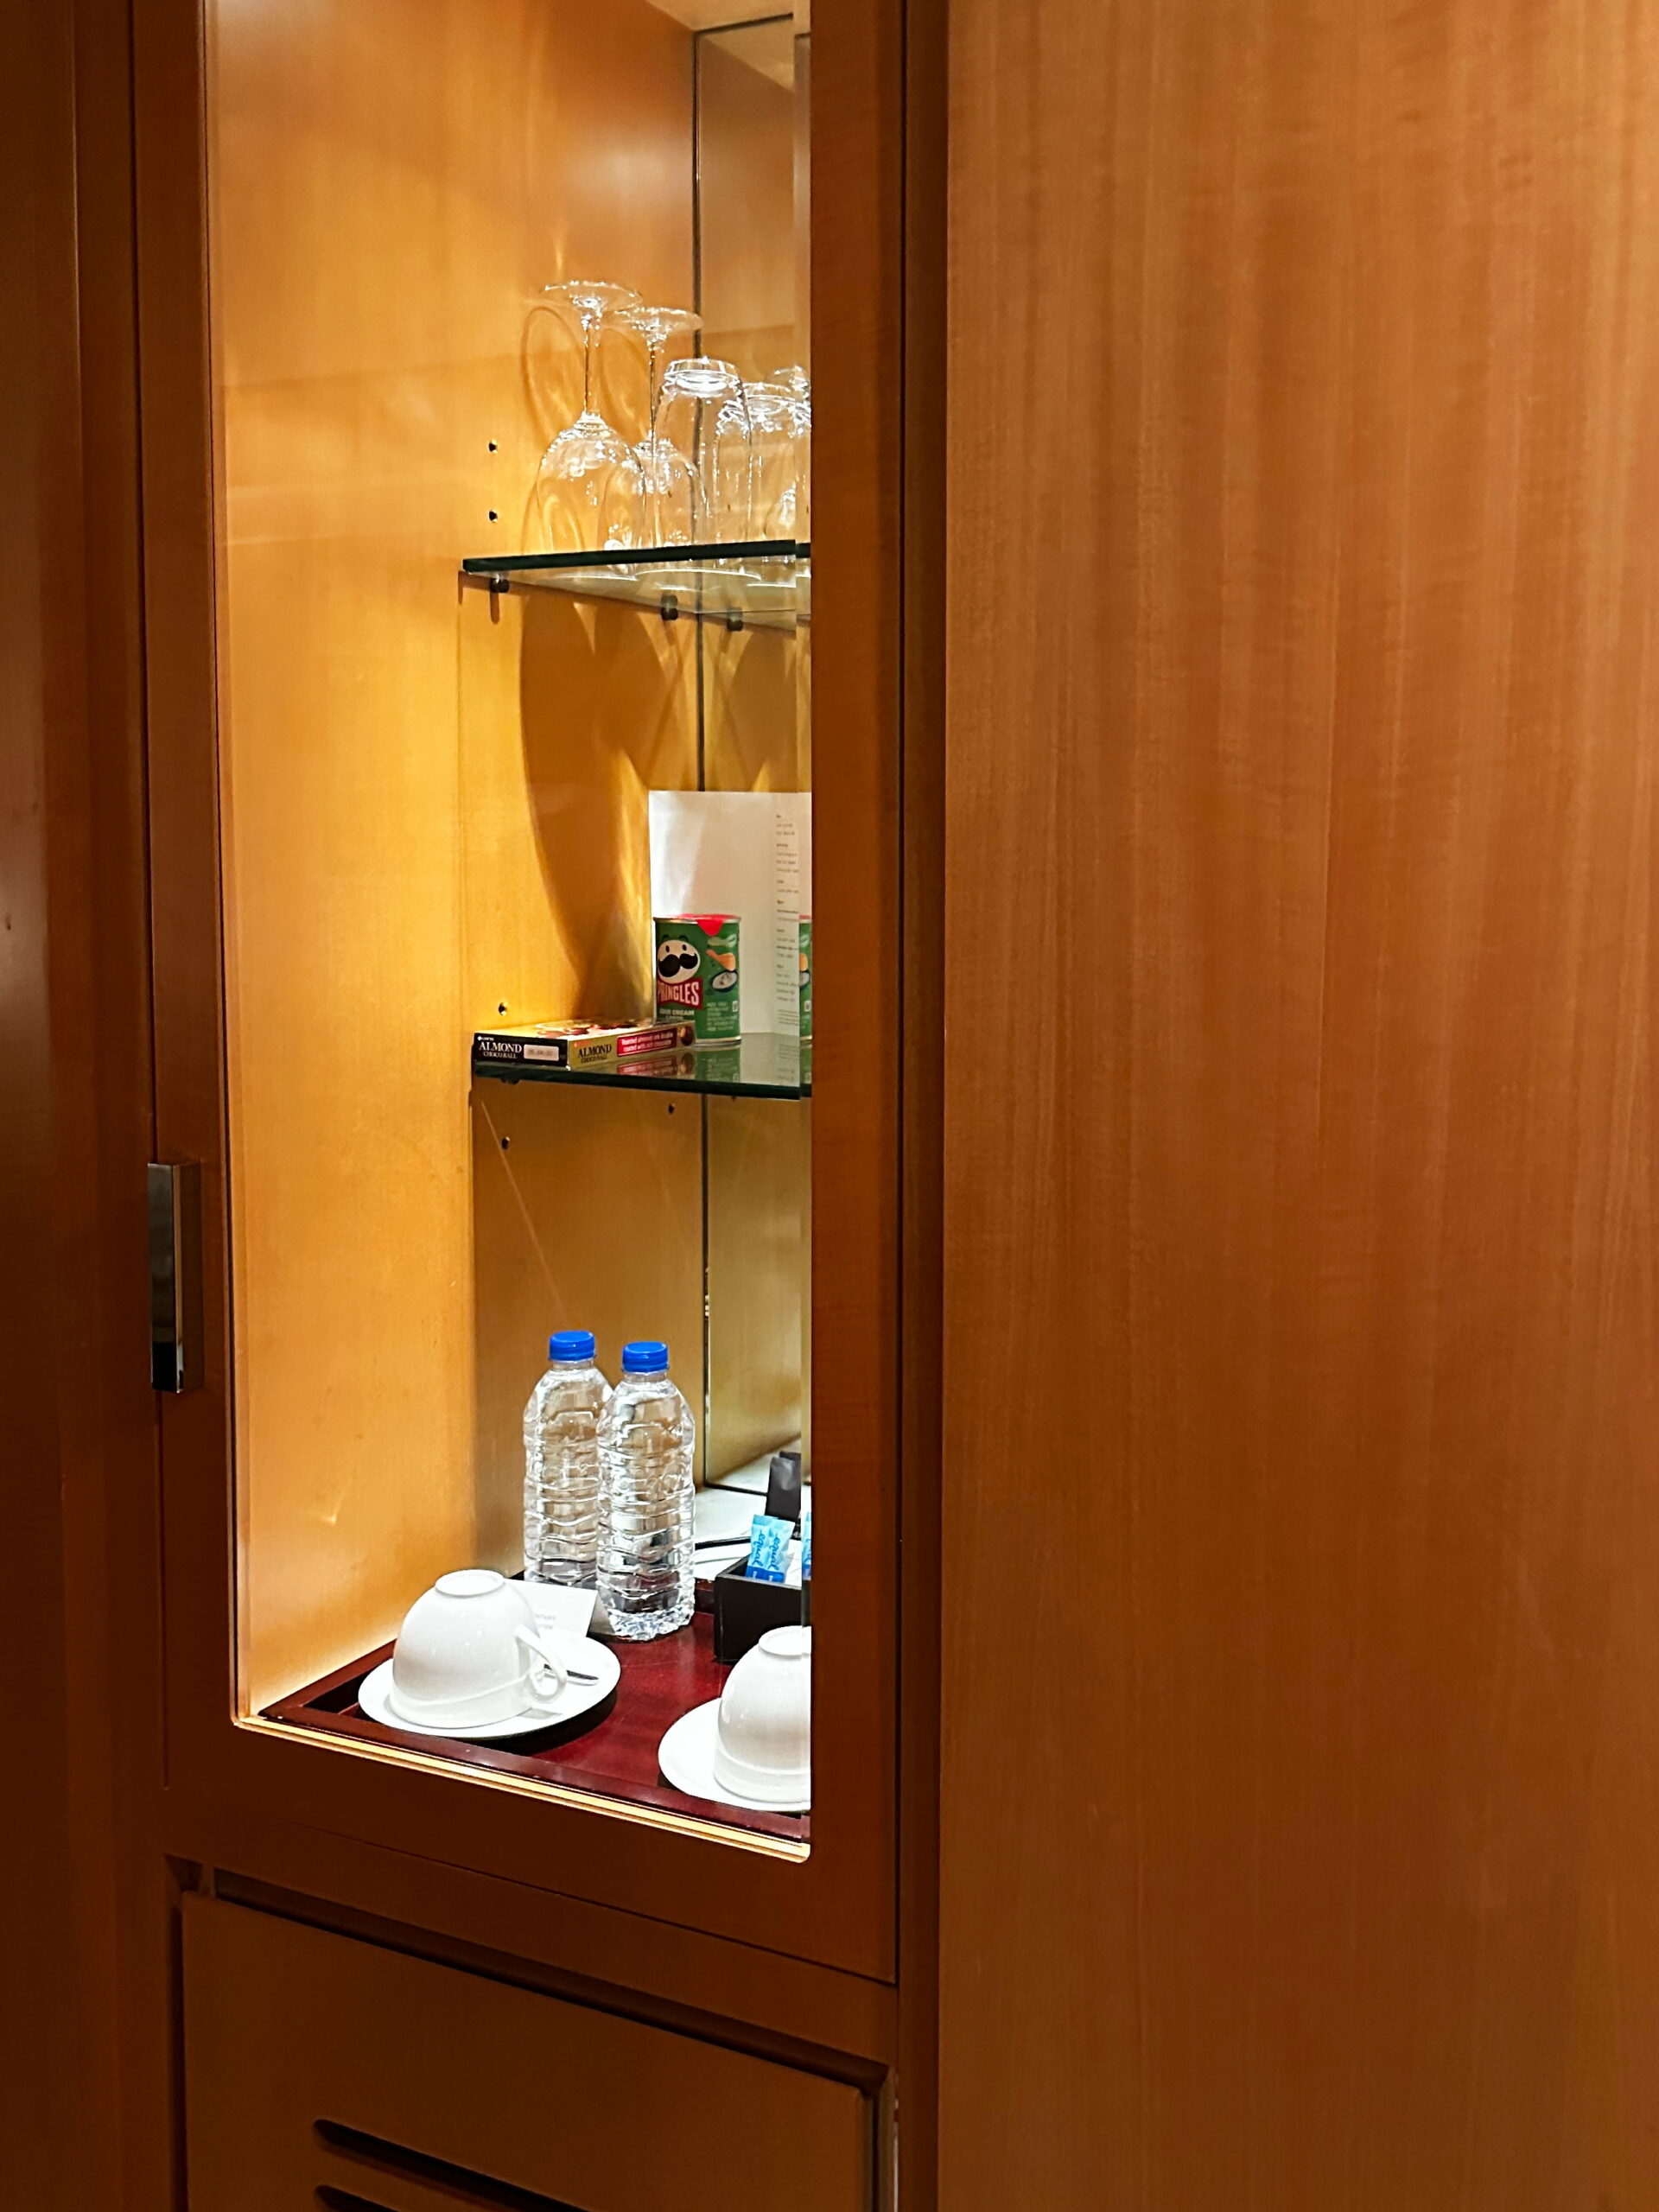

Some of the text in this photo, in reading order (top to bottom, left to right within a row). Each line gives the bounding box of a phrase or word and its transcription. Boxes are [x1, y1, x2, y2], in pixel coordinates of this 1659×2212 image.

[479, 1041, 523, 1053] ALMOND
[578, 1044, 613, 1059] ALMOND
[751, 1529, 766, 1567] equal
[767, 1533, 781, 1571] equal
